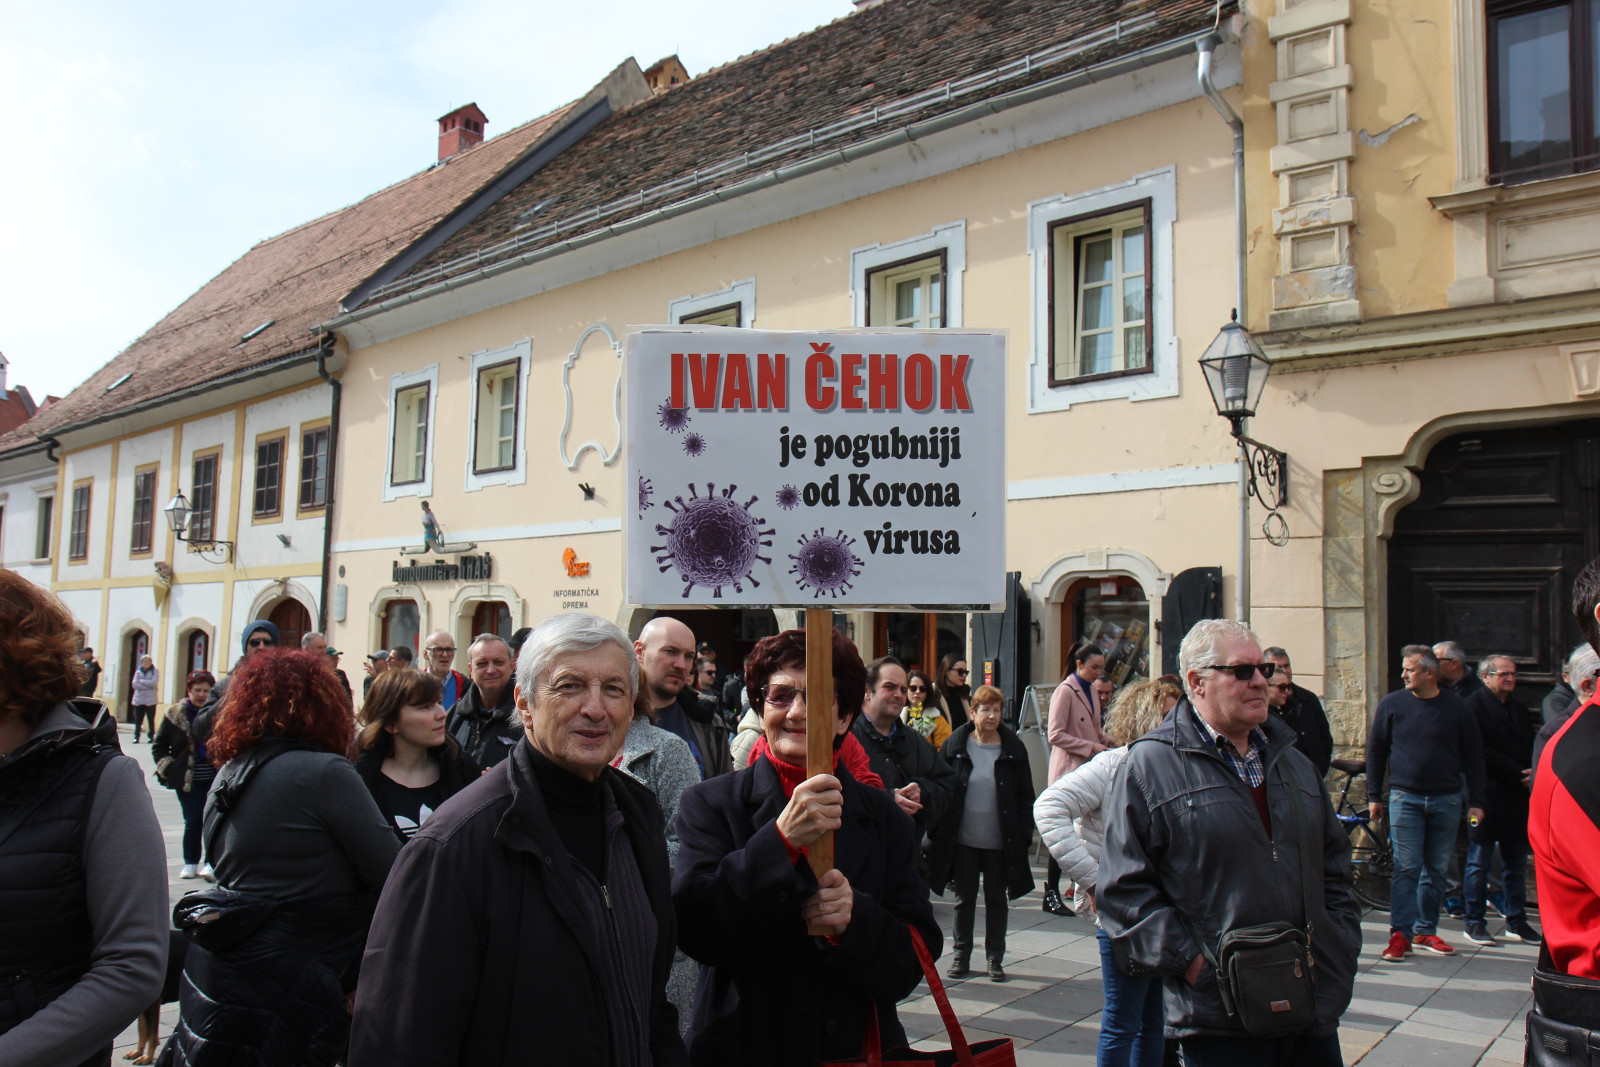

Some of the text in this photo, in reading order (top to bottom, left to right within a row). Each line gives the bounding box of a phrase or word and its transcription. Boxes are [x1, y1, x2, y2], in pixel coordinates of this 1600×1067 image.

[671, 343, 969, 410] IVAN ČEHOK
[780, 426, 961, 467] je pogubniji
[803, 474, 960, 506] od Korona
[864, 522, 960, 554] virusa
[460, 552, 491, 579] KRAŠ
[553, 587, 599, 597] INFORMATIČKA
[562, 601, 588, 609] OPREMA
